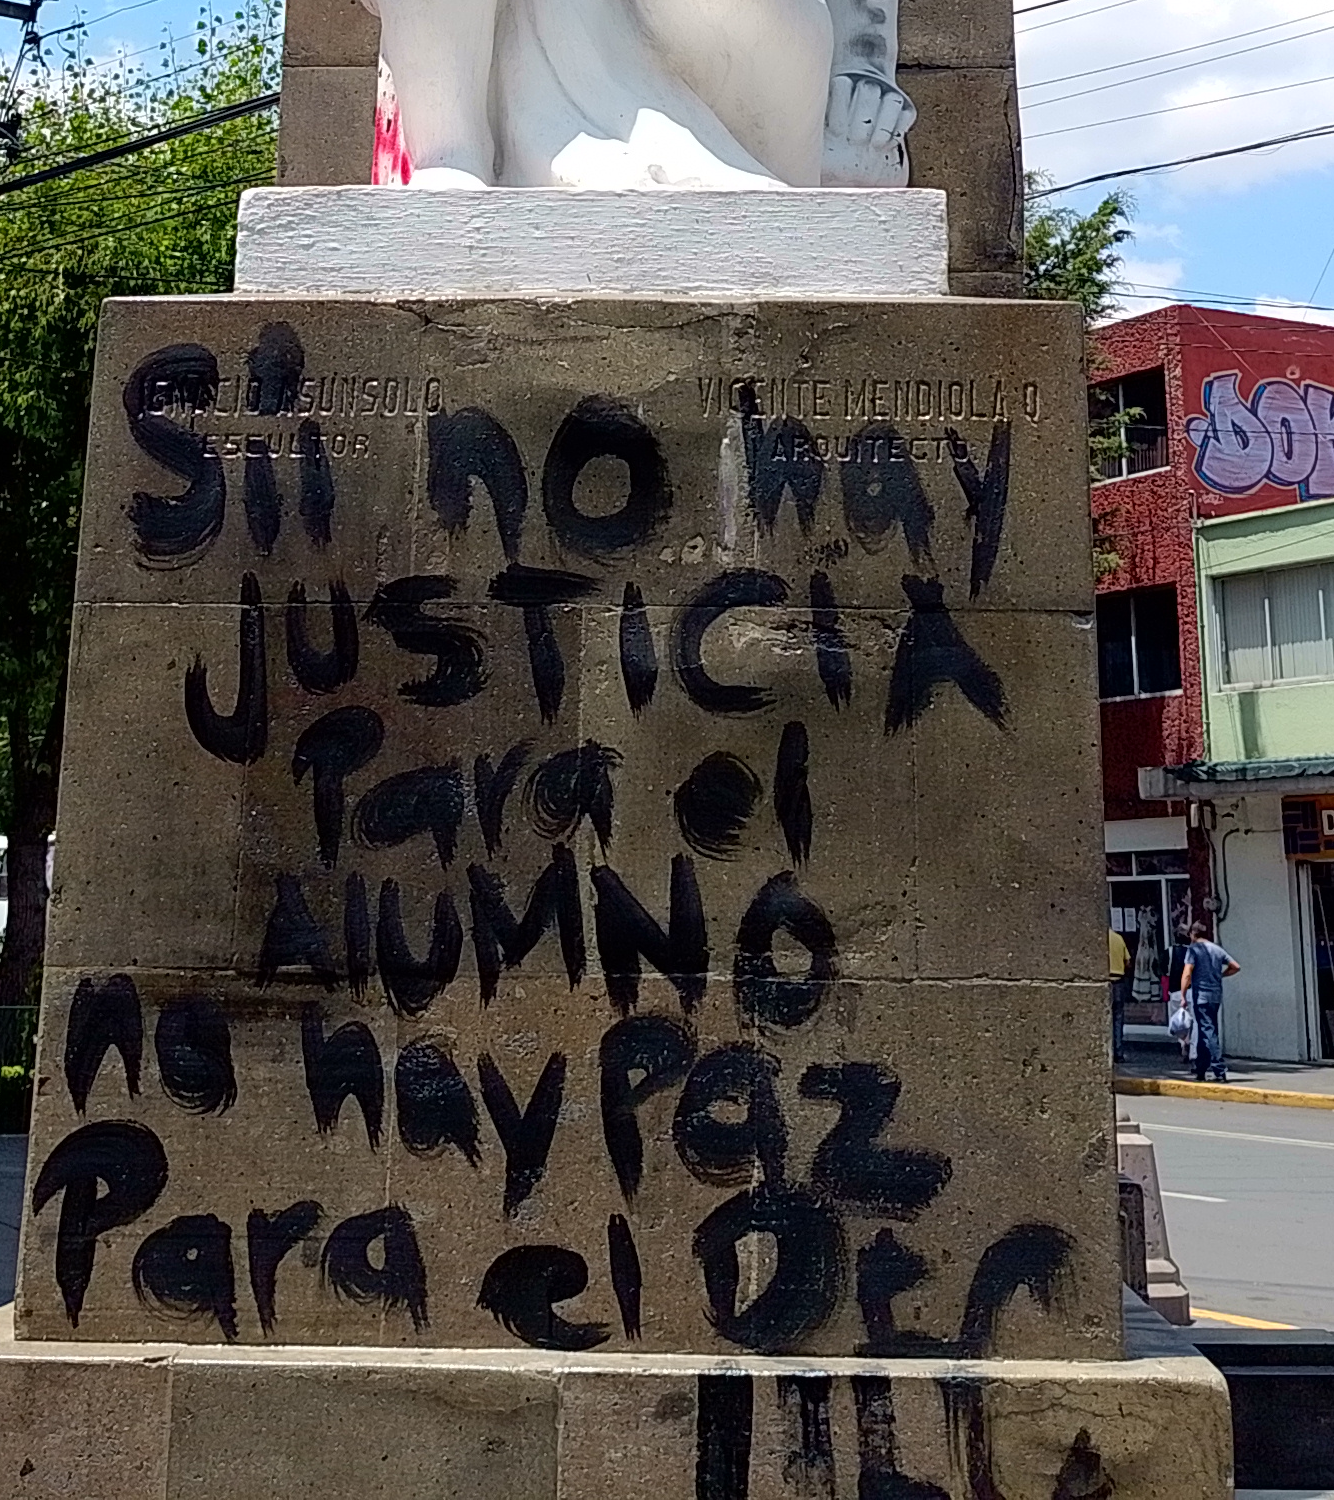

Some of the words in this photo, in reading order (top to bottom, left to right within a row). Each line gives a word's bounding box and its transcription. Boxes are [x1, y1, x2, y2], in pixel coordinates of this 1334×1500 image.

[697, 377, 833, 422] VICENTE
[843, 377, 1012, 422] MENDIOLA
[185, 566, 1013, 766] JUSTICIA
